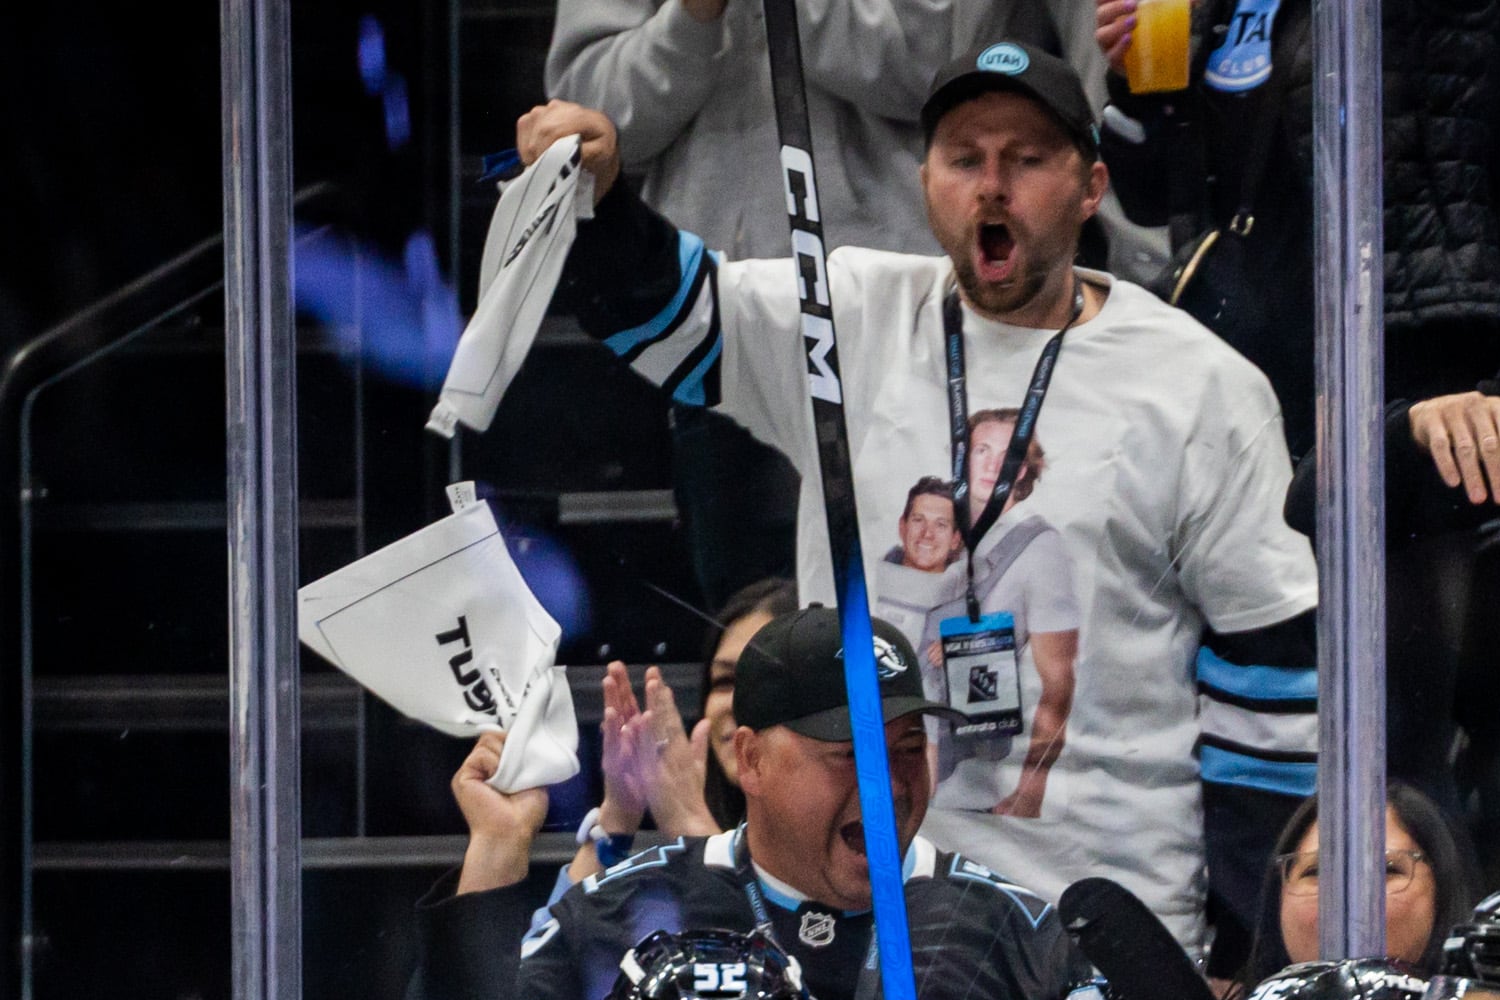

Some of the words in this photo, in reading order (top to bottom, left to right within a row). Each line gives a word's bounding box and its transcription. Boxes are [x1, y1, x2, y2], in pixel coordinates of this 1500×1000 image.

[1234, 11, 1270, 47] TA
[985, 53, 1020, 66] UTAH
[780, 144, 842, 405] CCM
[435, 615, 498, 717] TUS
[694, 963, 747, 991] 52
